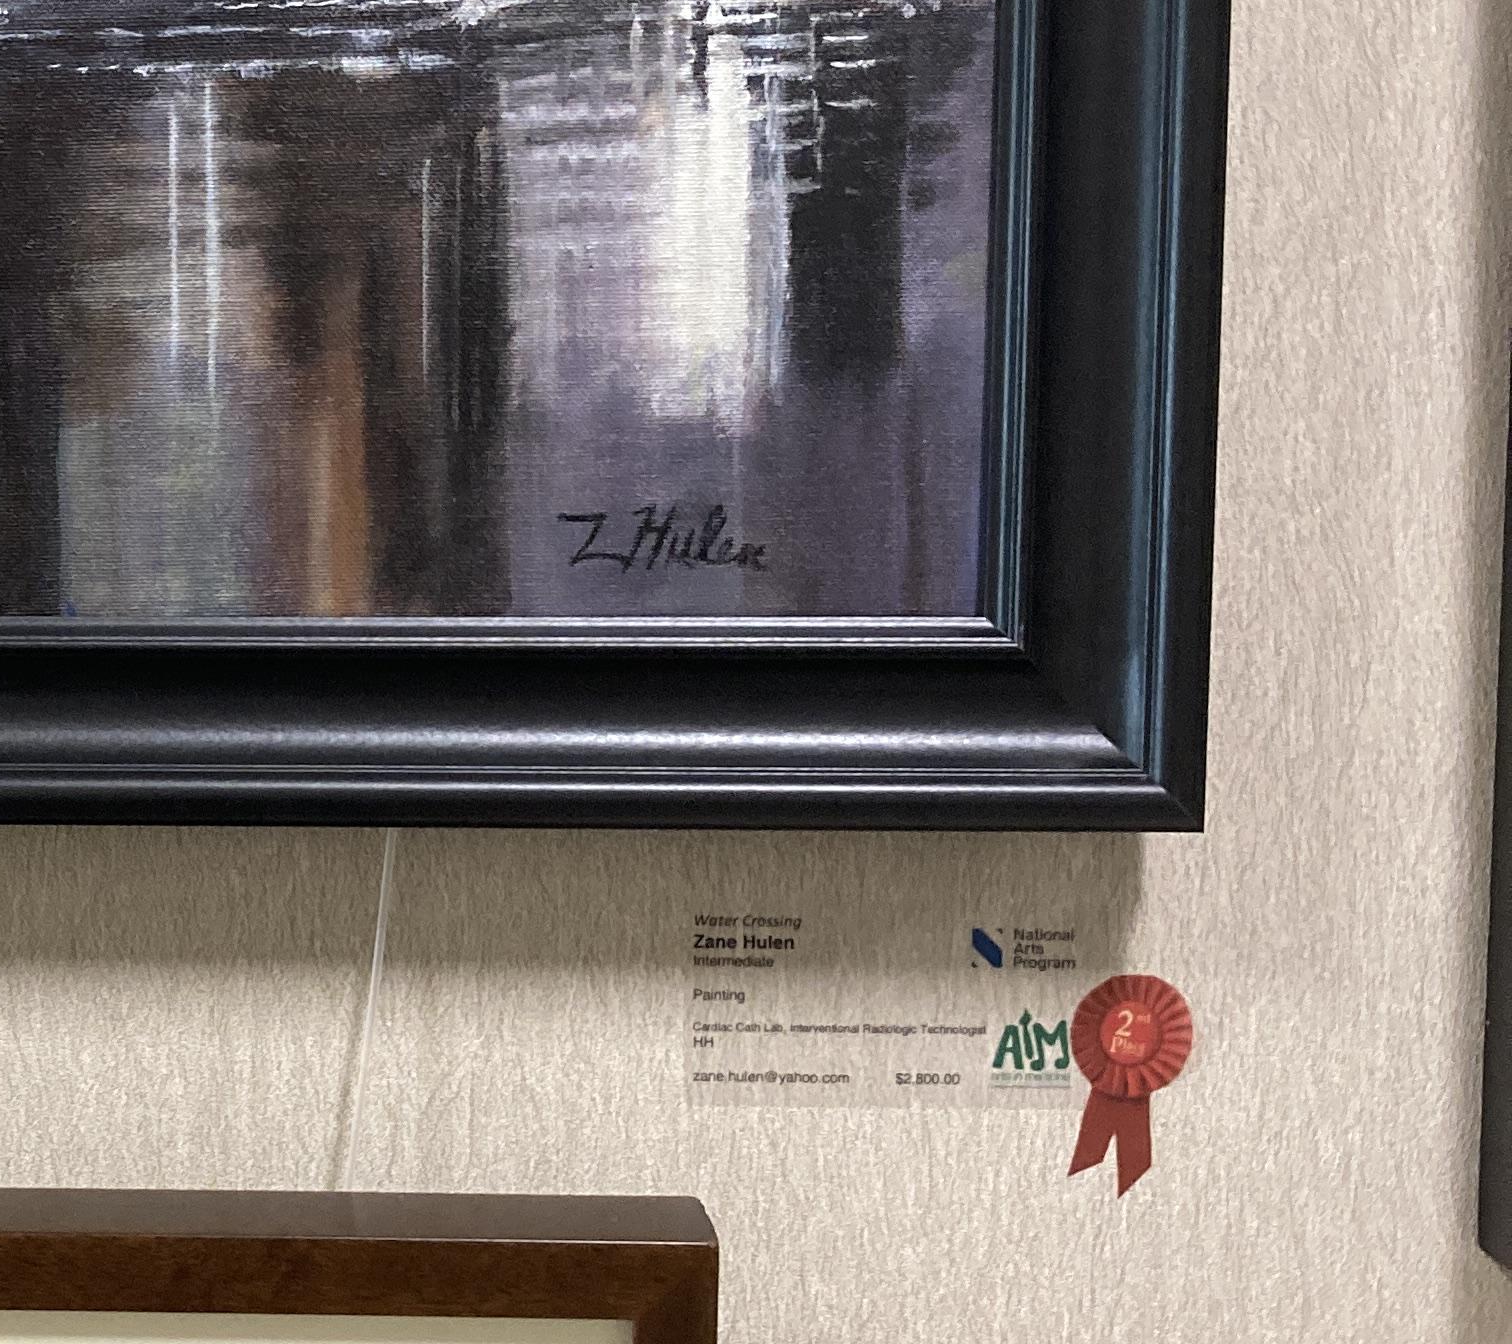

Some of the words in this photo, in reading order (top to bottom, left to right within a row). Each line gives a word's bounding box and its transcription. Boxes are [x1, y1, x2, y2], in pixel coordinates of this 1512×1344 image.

[693, 914, 738, 927] Water
[742, 915, 802, 930] Crossing
[693, 934, 738, 949] Zane
[742, 935, 795, 950] Hulen
[1013, 927, 1075, 942] National
[1014, 942, 1045, 955] Arts
[693, 955, 775, 968] Intermediate
[1013, 956, 1076, 972] Program
[693, 988, 746, 1004] Painting
[692, 1021, 733, 1033] Cardiac
[735, 1022, 761, 1033] Cath
[790, 1023, 860, 1034] Interventional
[862, 1023, 918, 1037] Radiologic
[692, 1036, 715, 1049] HH
[692, 1070, 851, 1086] zane.hulen@yahoo.com
